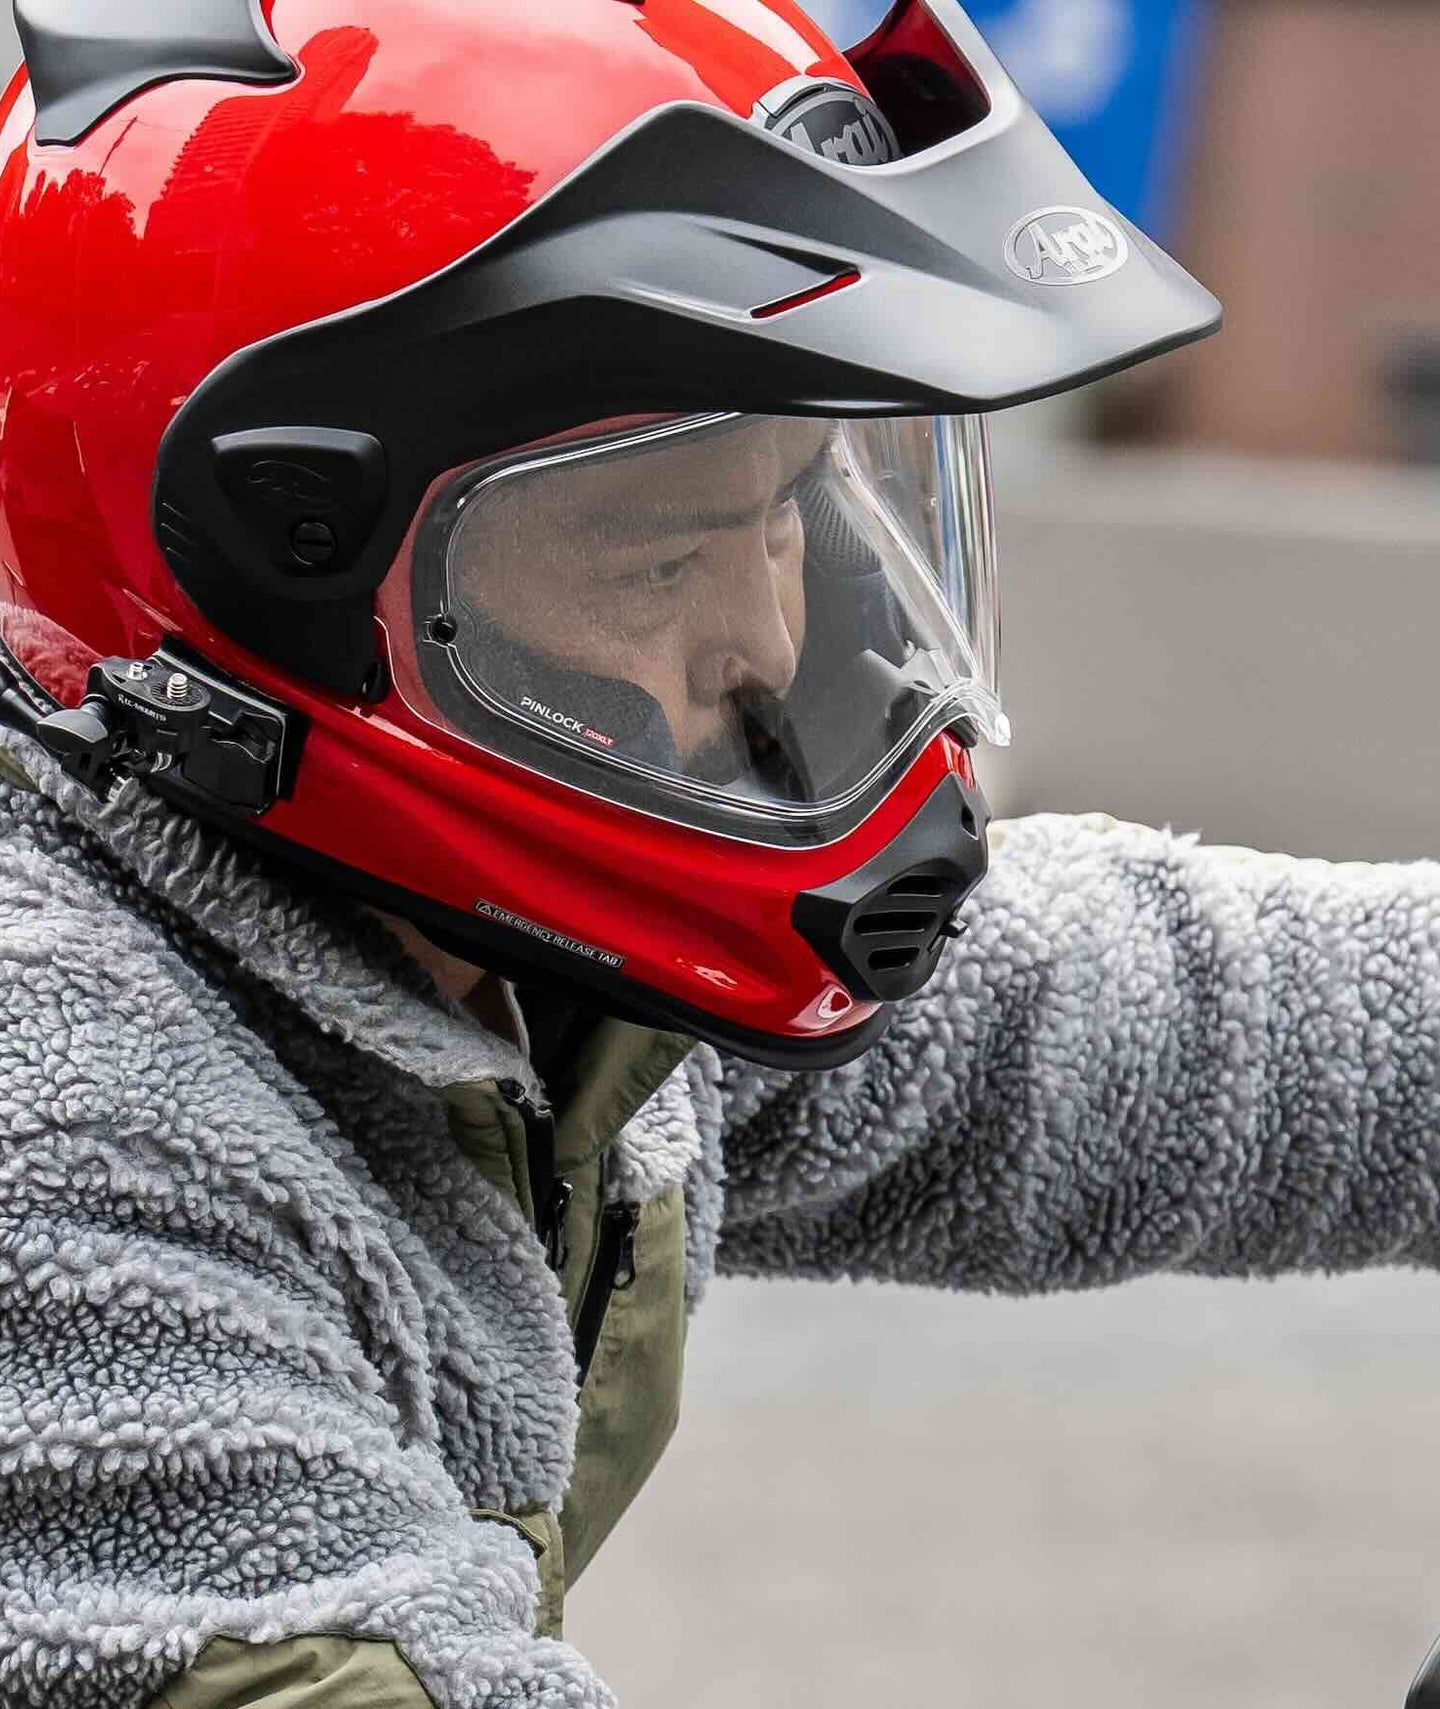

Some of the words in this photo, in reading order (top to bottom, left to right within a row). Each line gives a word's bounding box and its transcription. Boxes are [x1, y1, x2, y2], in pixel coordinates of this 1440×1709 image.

[1024, 214, 1114, 280] Arai
[520, 696, 584, 734] PINLOCK
[493, 909, 552, 943] EMERGENCY
[553, 935, 594, 957] RELEASE
